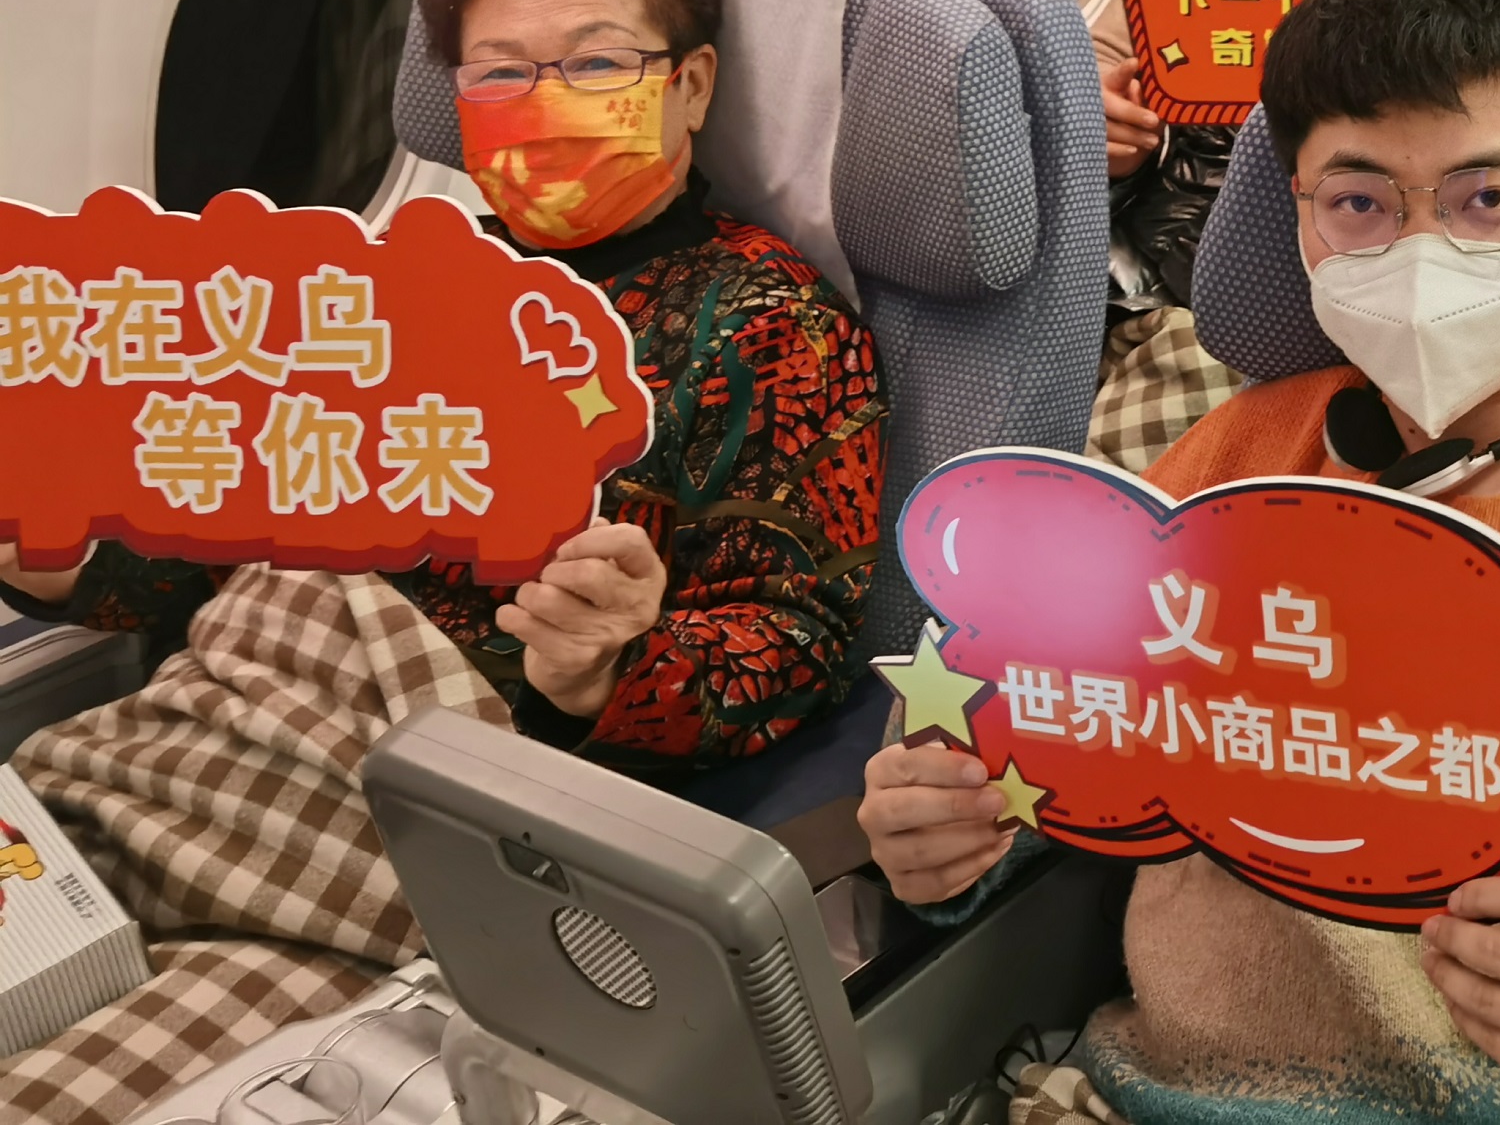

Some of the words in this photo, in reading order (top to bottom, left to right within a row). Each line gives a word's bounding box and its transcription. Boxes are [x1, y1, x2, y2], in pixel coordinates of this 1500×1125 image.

[1210, 28, 1272, 67] 奇
[0, 264, 392, 388] 我在义乌
[134, 390, 494, 517] 等你来
[1141, 574, 1334, 679] 义乌
